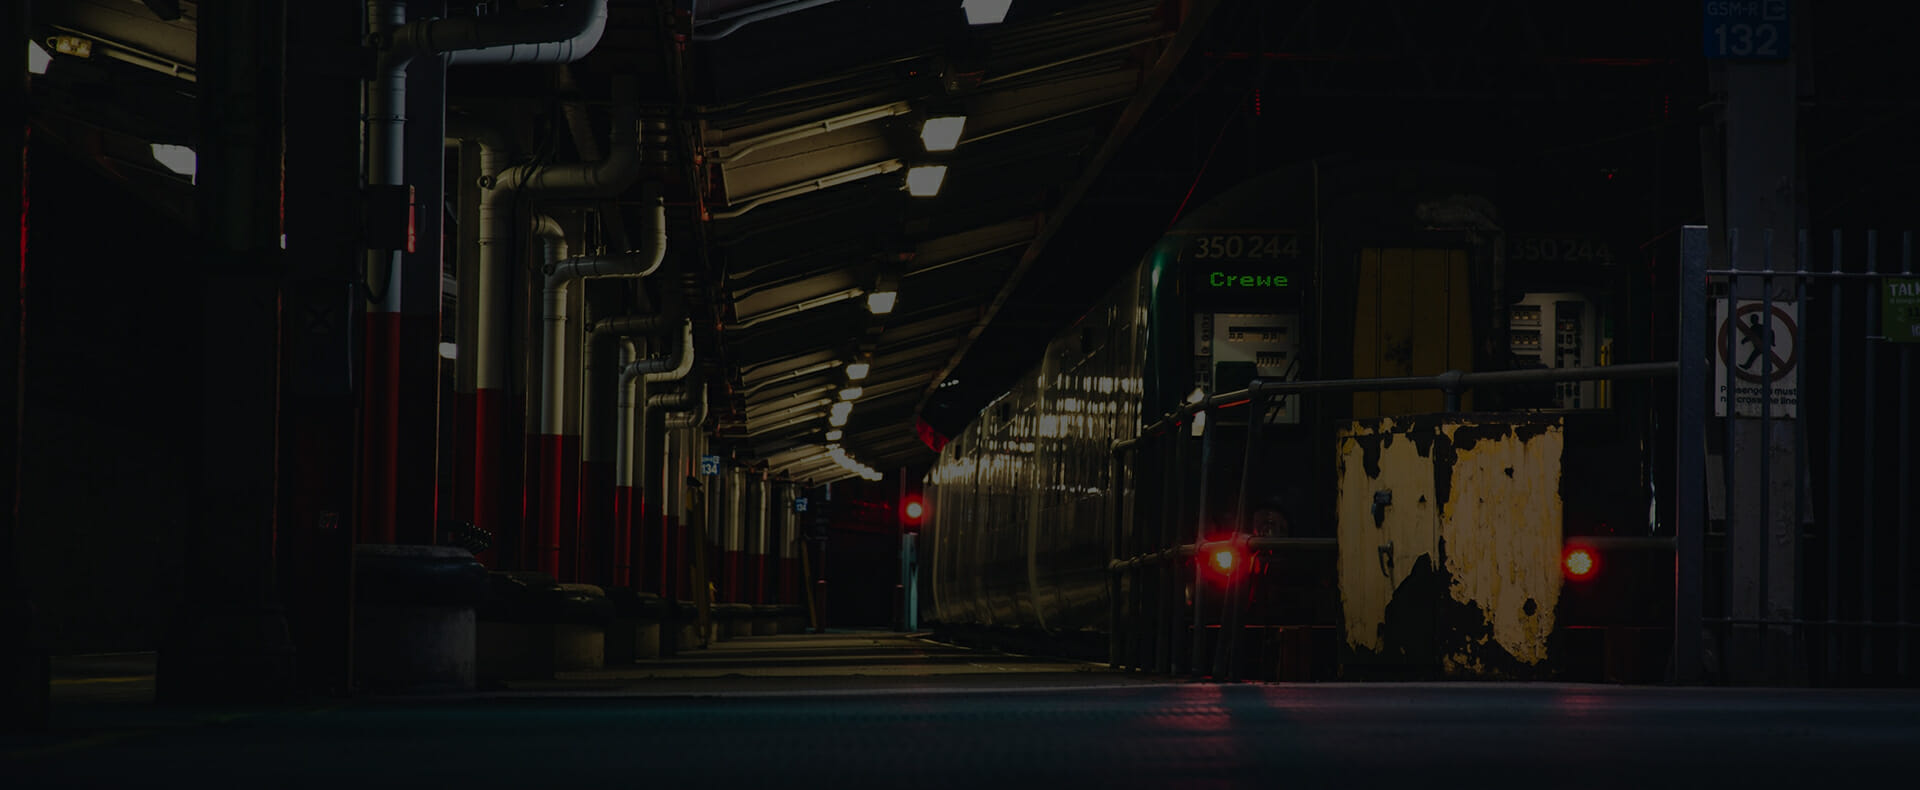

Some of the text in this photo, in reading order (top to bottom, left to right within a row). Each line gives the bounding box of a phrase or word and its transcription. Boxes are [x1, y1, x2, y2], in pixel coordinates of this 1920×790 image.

[1707, 1, 1759, 16] GSM-R
[1713, 24, 1777, 56] 132
[1193, 235, 1301, 260] 350 244
[1511, 239, 1558, 262] 350
[1209, 272, 1289, 288] Crewe
